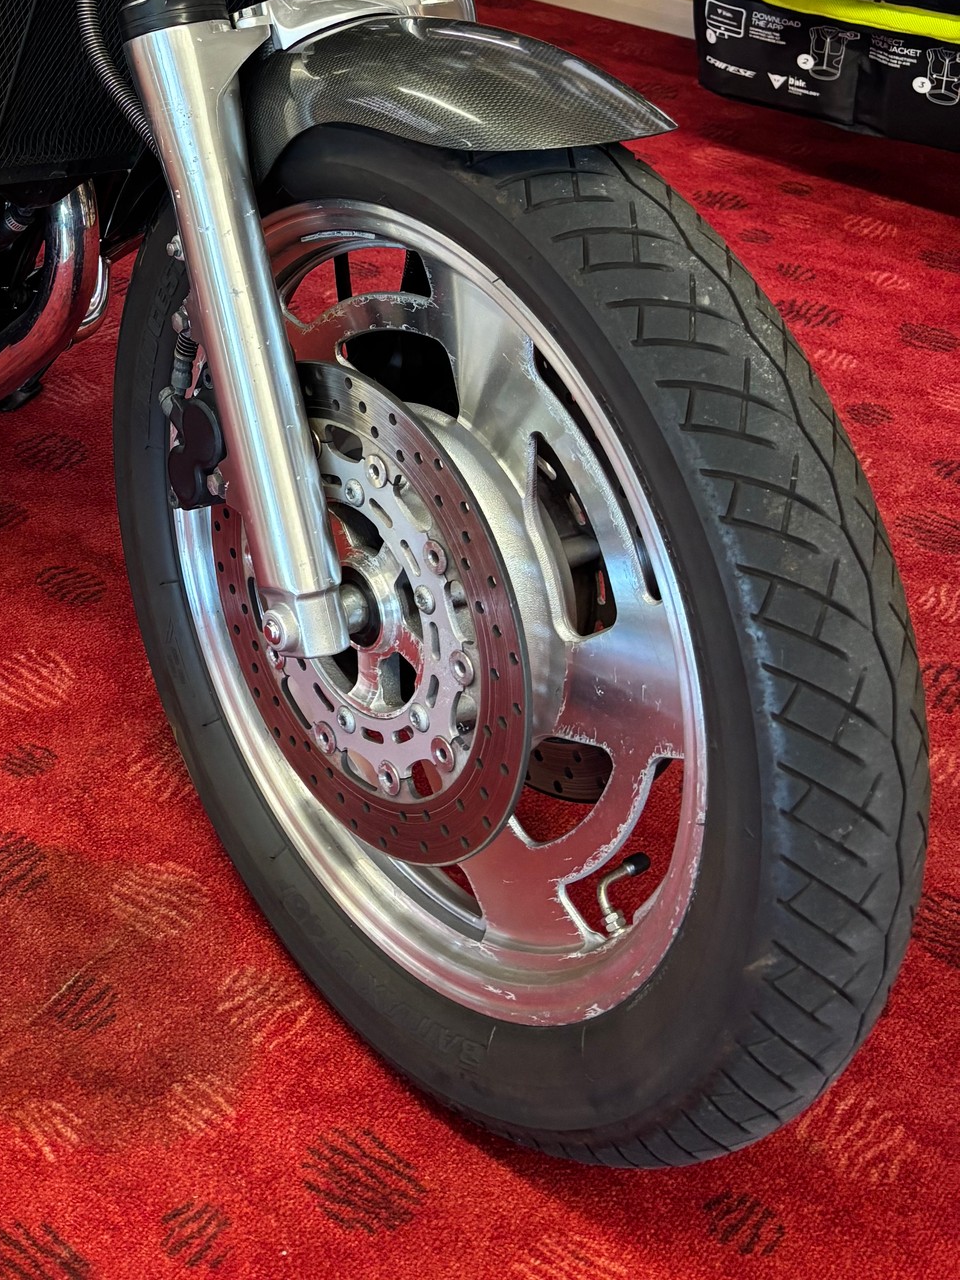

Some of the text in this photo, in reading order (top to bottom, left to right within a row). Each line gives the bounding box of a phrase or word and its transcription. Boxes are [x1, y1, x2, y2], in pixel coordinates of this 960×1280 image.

[751, 18, 784, 30] THE APP
[752, 11, 801, 28] DOWNLOAD
[889, 46, 922, 57] JACKET
[706, 55, 757, 78] DAINESE
[918, 81, 926, 89] 3
